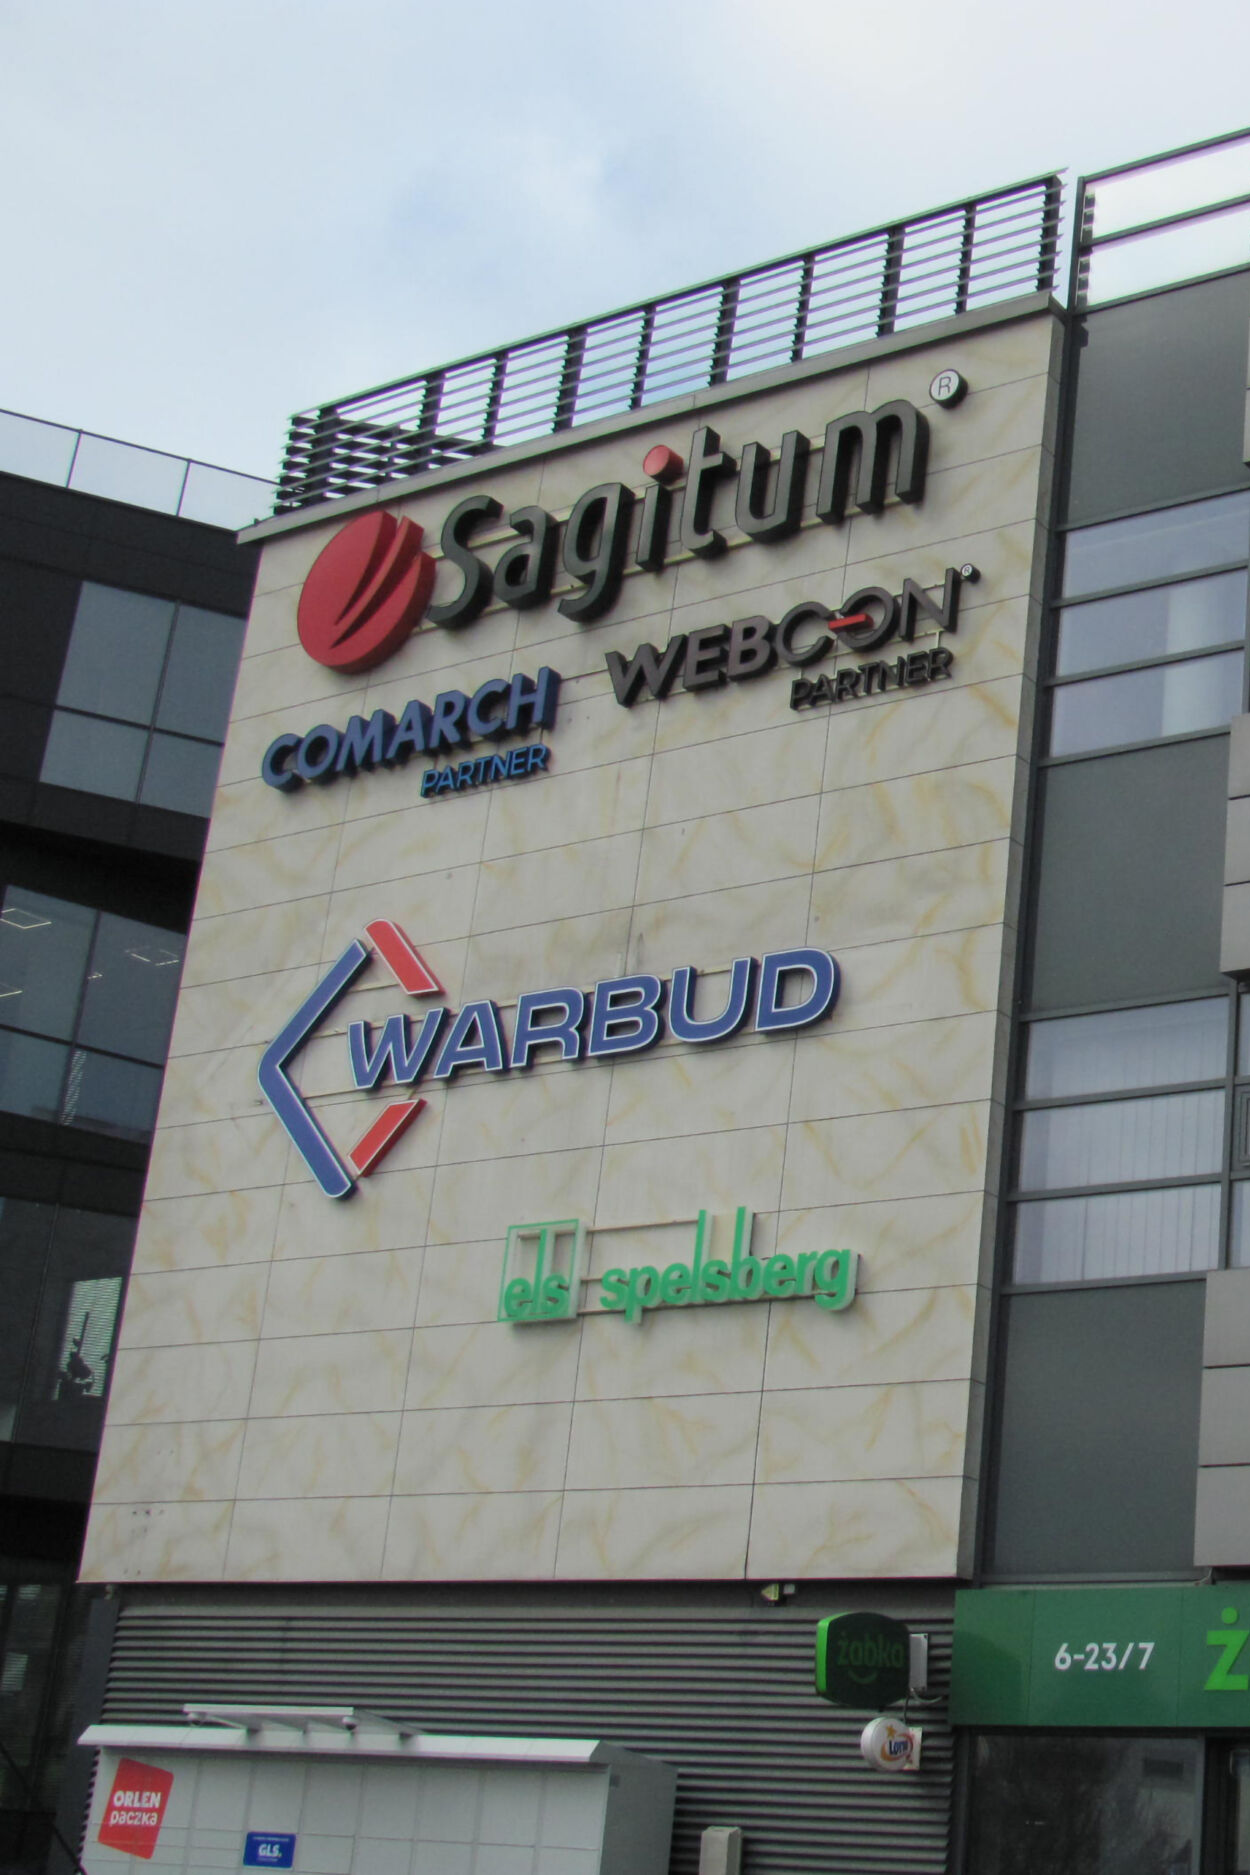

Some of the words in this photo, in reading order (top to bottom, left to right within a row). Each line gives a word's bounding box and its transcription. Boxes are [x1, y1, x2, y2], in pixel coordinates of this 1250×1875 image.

[427, 399, 929, 629] Sagitum
[605, 567, 962, 708] WEBCON
[790, 647, 953, 709] PARTNER
[261, 666, 561, 791] COMARCH
[421, 743, 550, 797] PARTNER
[347, 947, 840, 1090] WARBUD
[503, 1228, 571, 1317] els
[600, 1206, 859, 1323] spelsberg
[1054, 1641, 1154, 1672] 6-23/7
[110, 1811, 158, 1827] paczka
[113, 1790, 161, 1808] ORLEN
